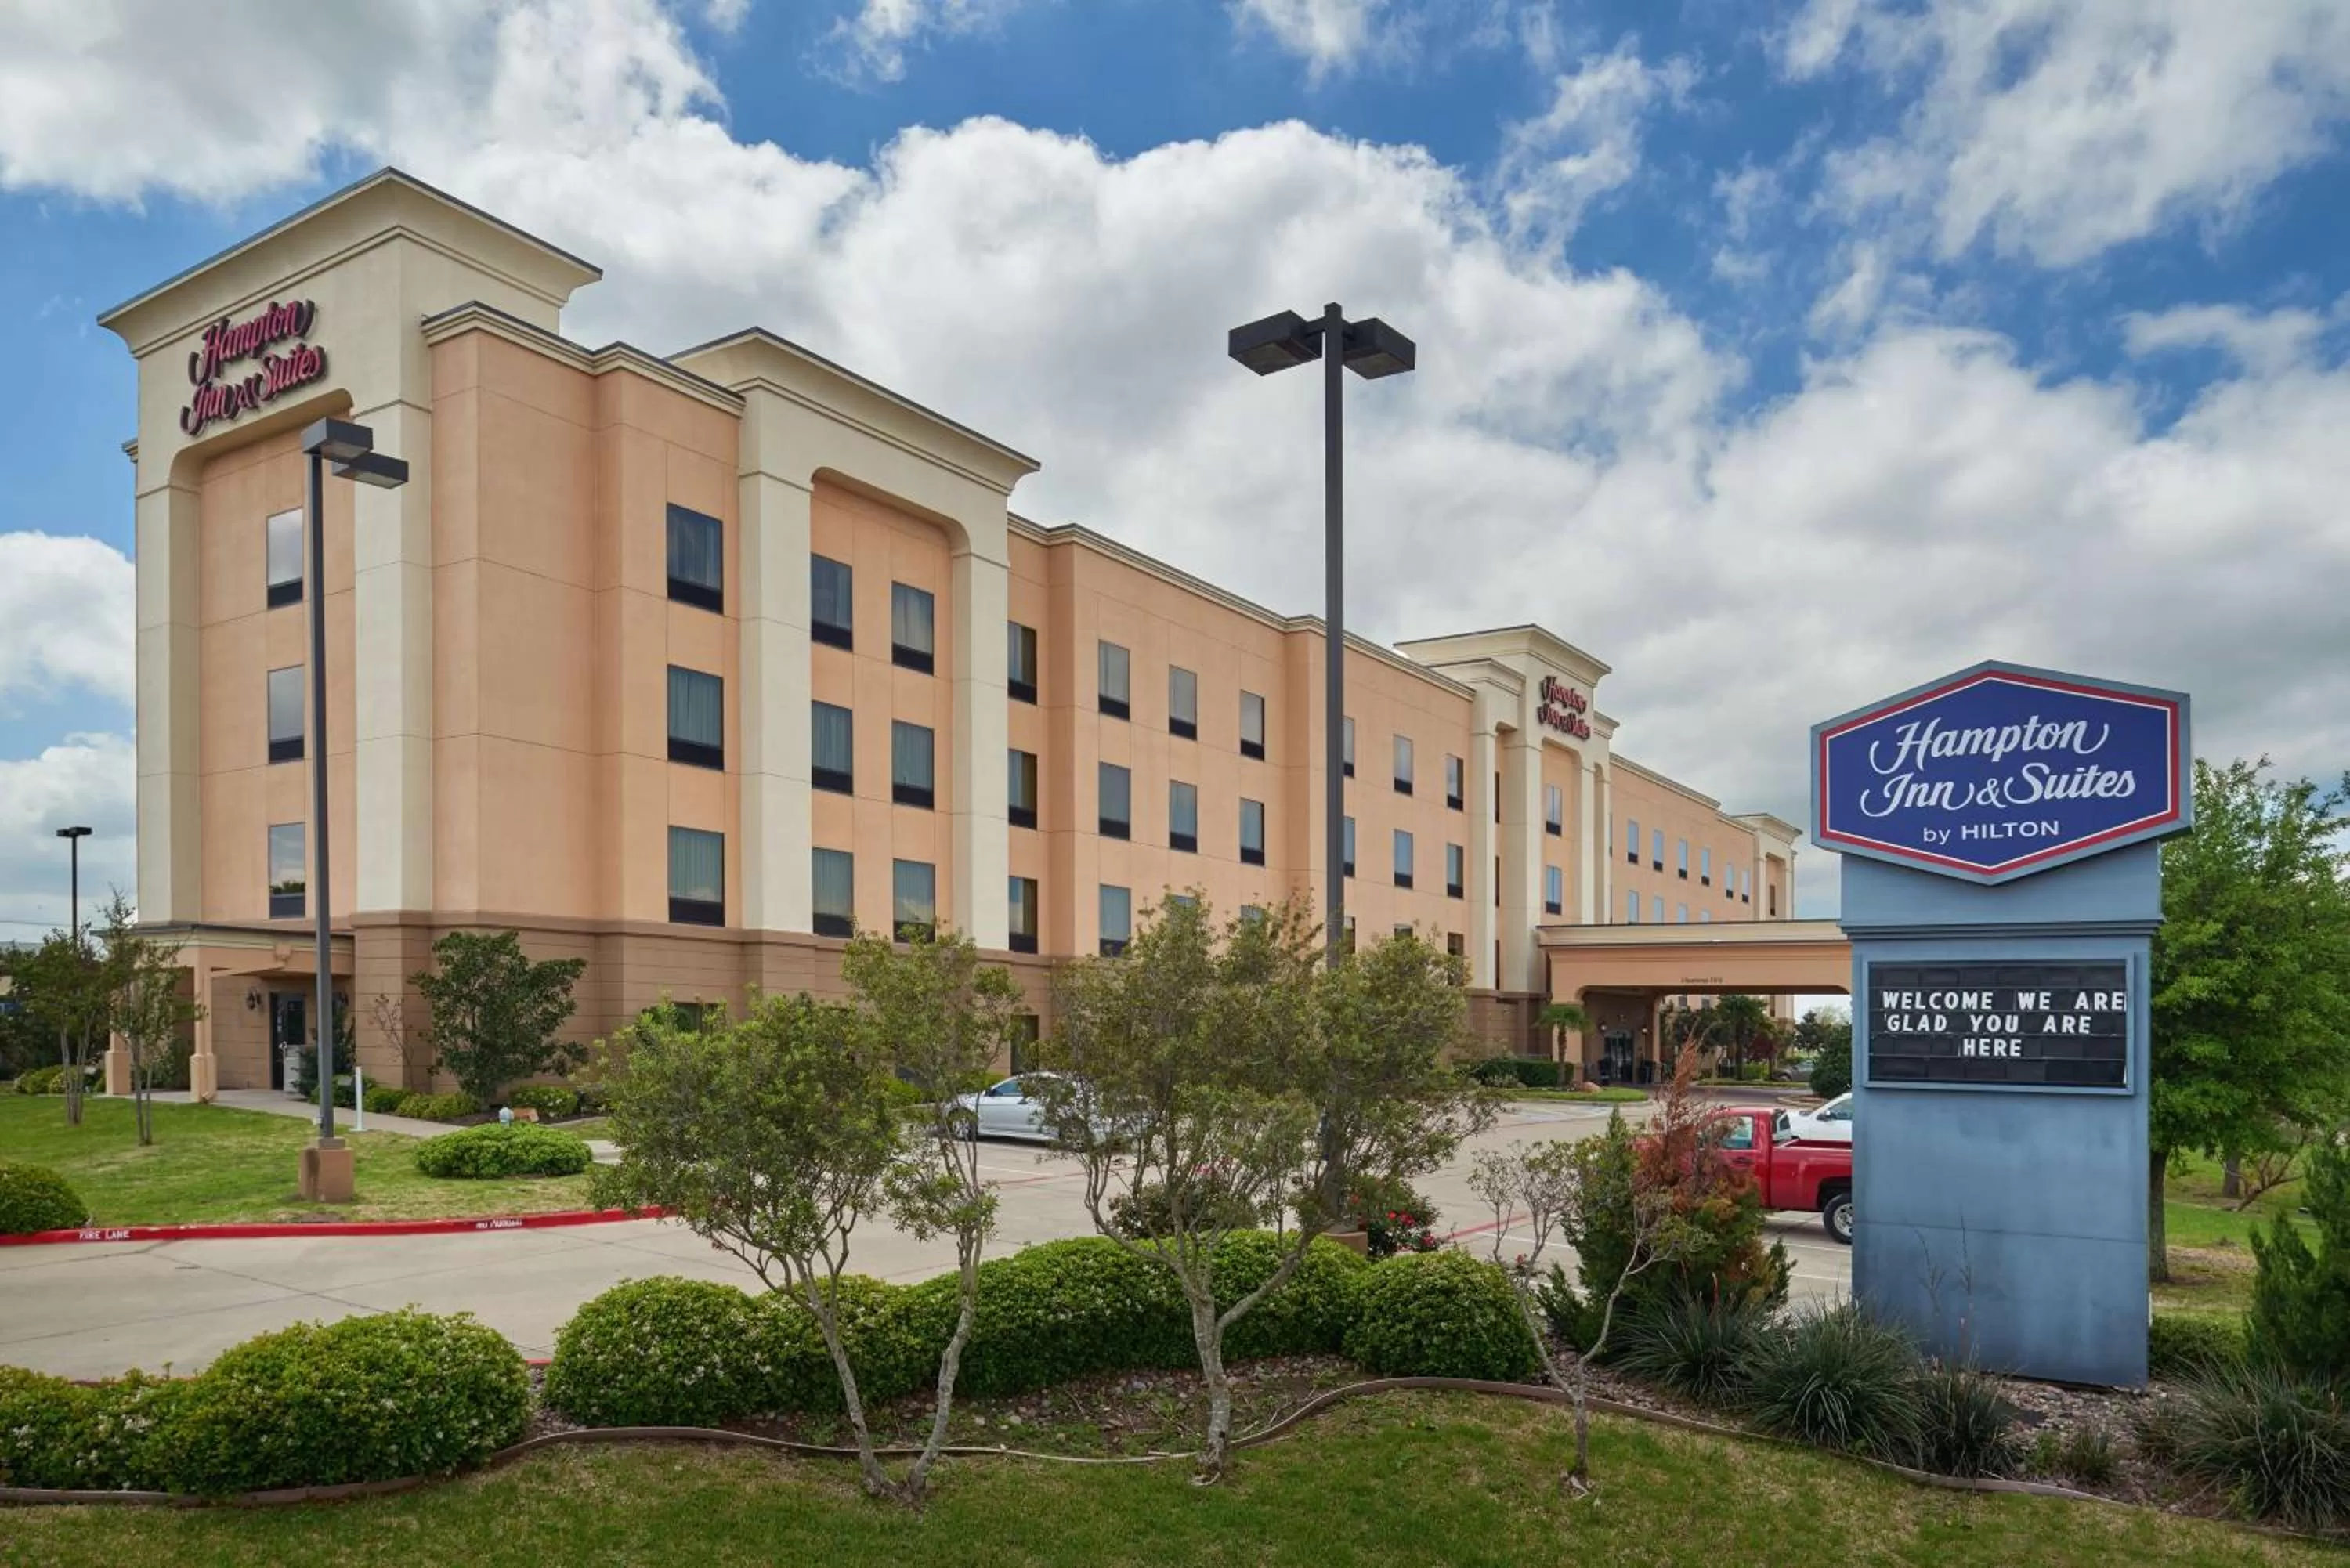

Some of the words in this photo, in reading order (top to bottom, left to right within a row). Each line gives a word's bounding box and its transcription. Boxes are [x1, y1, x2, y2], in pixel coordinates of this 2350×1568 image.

[188, 299, 316, 386] Hampton
[180, 381, 241, 435] Inn
[252, 342, 327, 401] Suites
[1869, 714, 2110, 775] Hampton
[1860, 772, 1975, 817] Inn
[1976, 777, 2007, 808] &
[2003, 762, 2136, 804] Suites
[1923, 827, 1951, 845] by
[1961, 820, 2059, 840] HILTON
[1882, 991, 1994, 1010] WELCOME
[2017, 992, 2052, 1010] WE
[2073, 991, 2124, 1010] ARE
[1886, 1013, 1947, 1032] GLAD
[1969, 1013, 2019, 1033] YOU
[2042, 1013, 2092, 1034] ARE
[1962, 1038, 2022, 1057] HERE
